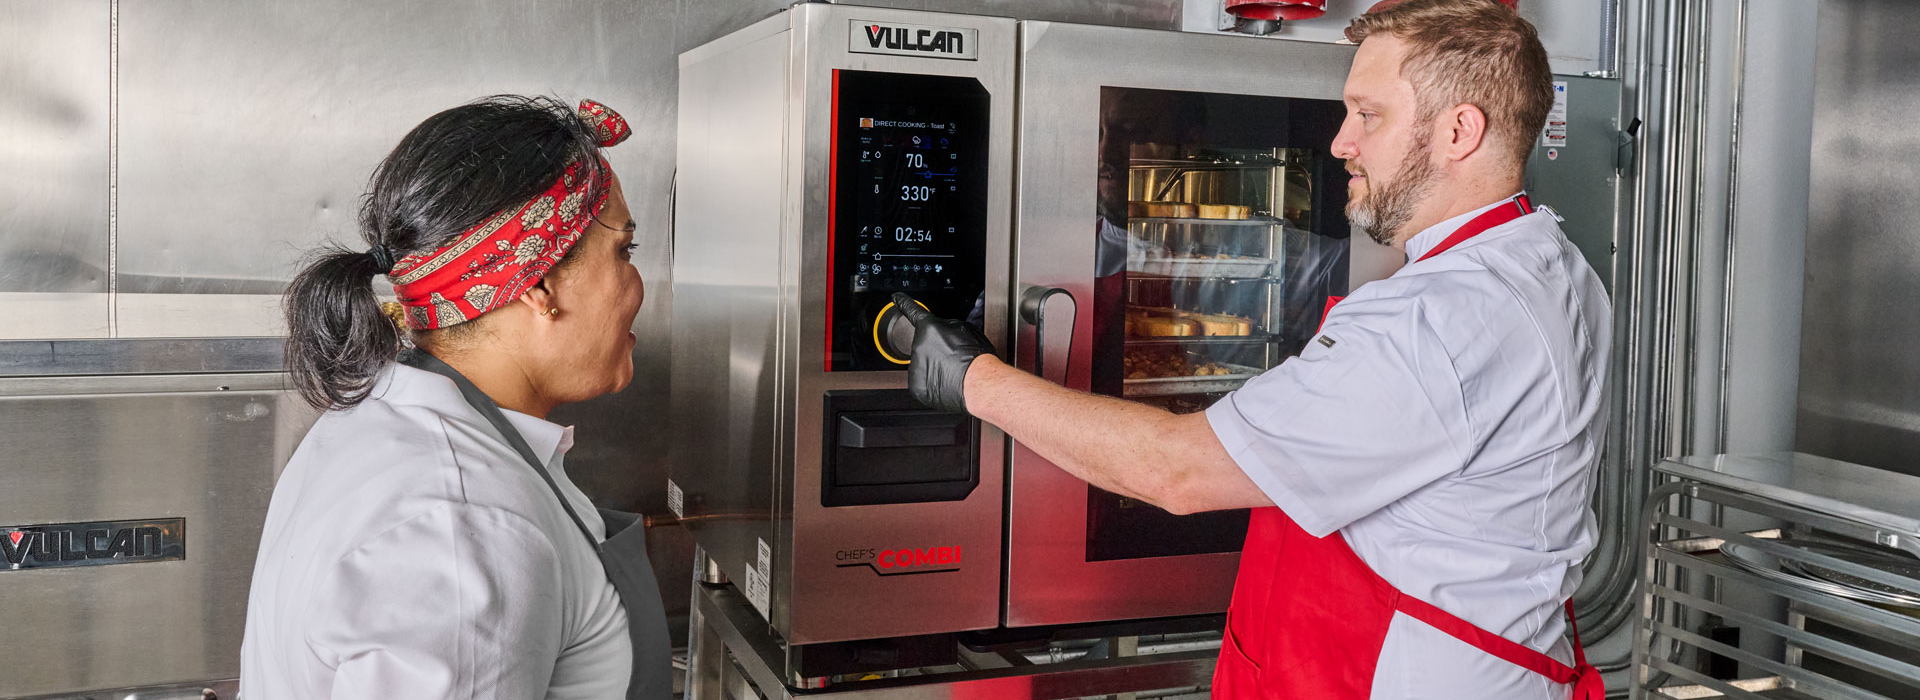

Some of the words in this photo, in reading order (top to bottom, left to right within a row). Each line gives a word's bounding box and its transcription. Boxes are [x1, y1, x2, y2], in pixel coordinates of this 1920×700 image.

[864, 25, 963, 54] VULCAN
[898, 121, 926, 129] COOKING
[895, 227, 932, 242] 02:54
[0, 527, 163, 565] VULCAN
[835, 548, 876, 561] CHEF'S
[878, 545, 962, 569] COMBI
